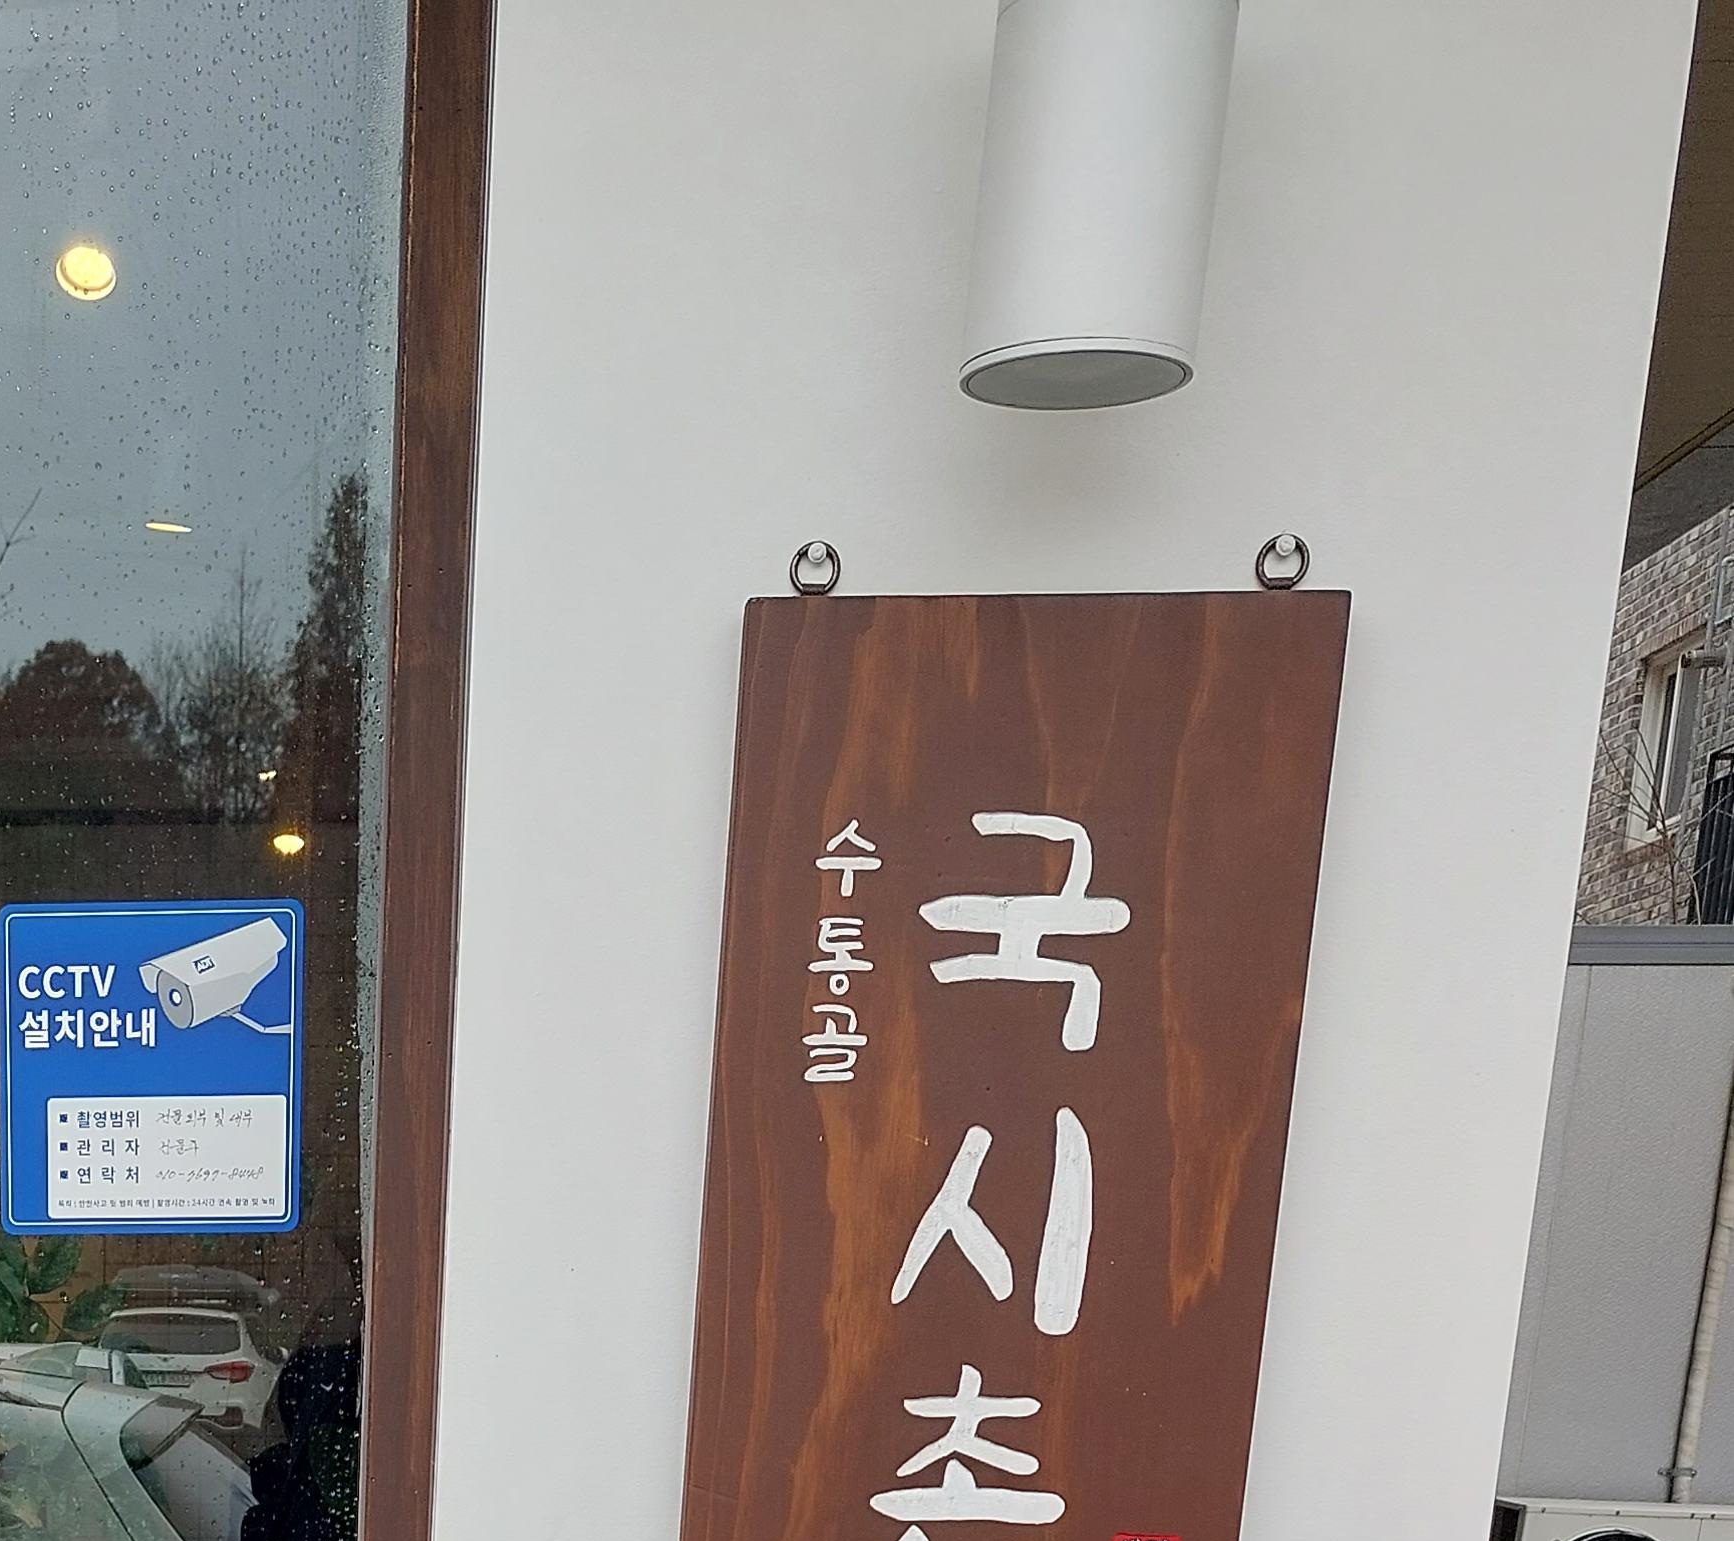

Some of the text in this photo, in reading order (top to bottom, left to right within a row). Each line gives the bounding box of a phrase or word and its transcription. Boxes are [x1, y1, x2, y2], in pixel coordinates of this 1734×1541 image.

[802, 819, 883, 1083] 수통골
[18, 965, 115, 999] CCTV
[18, 1008, 156, 1049] 설치안내
[77, 1110, 140, 1129] 촬영범위
